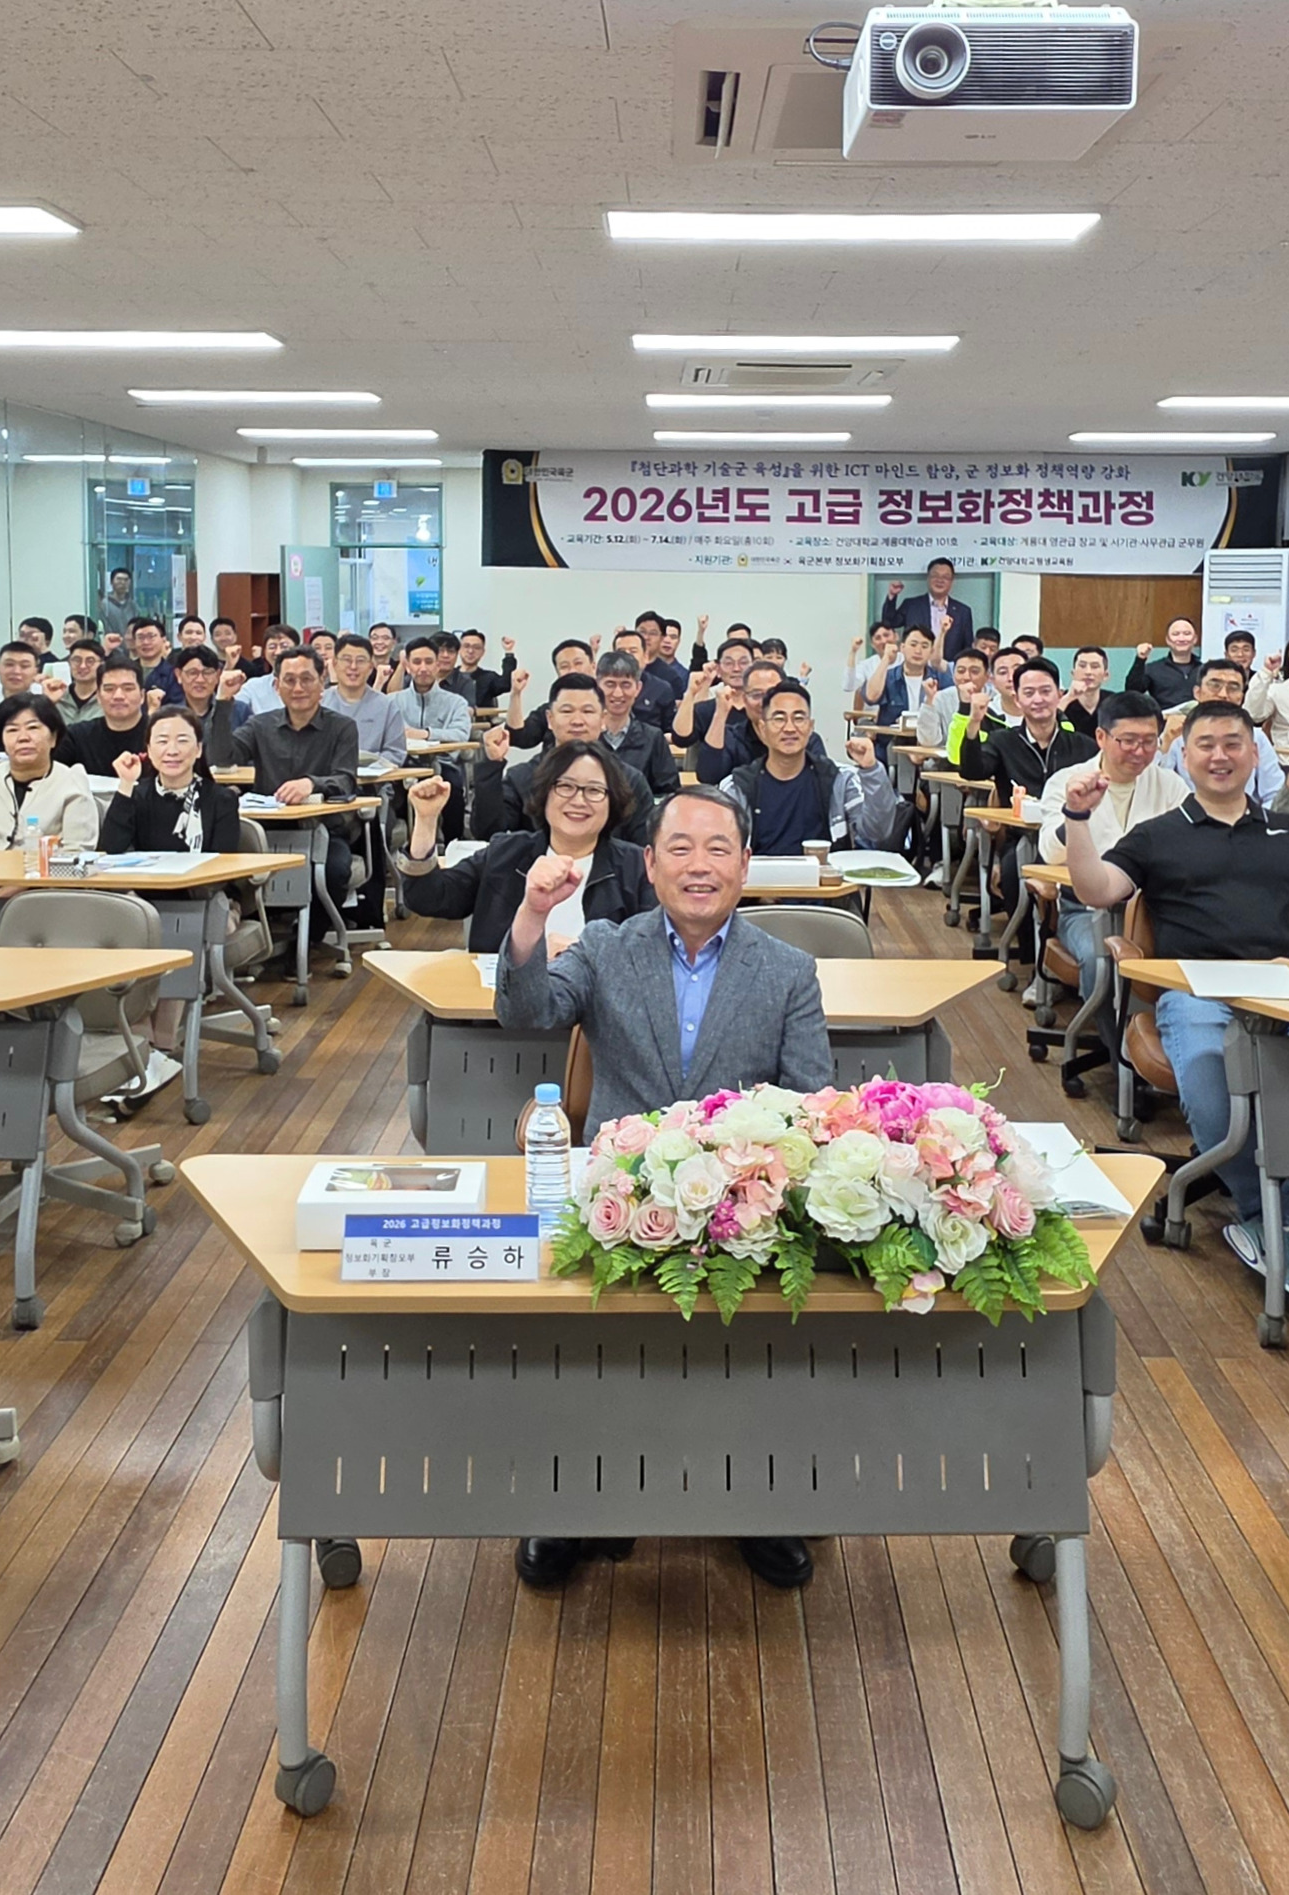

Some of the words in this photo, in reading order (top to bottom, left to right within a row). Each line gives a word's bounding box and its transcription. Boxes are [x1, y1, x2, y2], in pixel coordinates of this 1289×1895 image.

[704, 461, 748, 477] 기술군
[809, 462, 840, 478] 위한
[845, 464, 870, 477] ICT
[875, 462, 920, 479] 마인드
[926, 462, 960, 480] 함양,
[965, 464, 980, 479] 군
[985, 463, 1029, 479] 정보화
[1035, 463, 1095, 480] 정책역량
[1100, 464, 1131, 481] 강화
[583, 487, 771, 523] 2026년도
[786, 488, 863, 525] 고급
[878, 488, 1154, 526] 정보화정책과정
[567, 534, 604, 544] 교육기간:
[694, 535, 712, 545] 매주
[836, 536, 879, 547] 건양대학교
[936, 537, 958, 547] 101호
[1178, 537, 1204, 548] 군무원
[798, 556, 832, 566] 육군본부
[383, 1218, 407, 1229] 2026
[410, 1217, 502, 1230] 고급정보화정책과정
